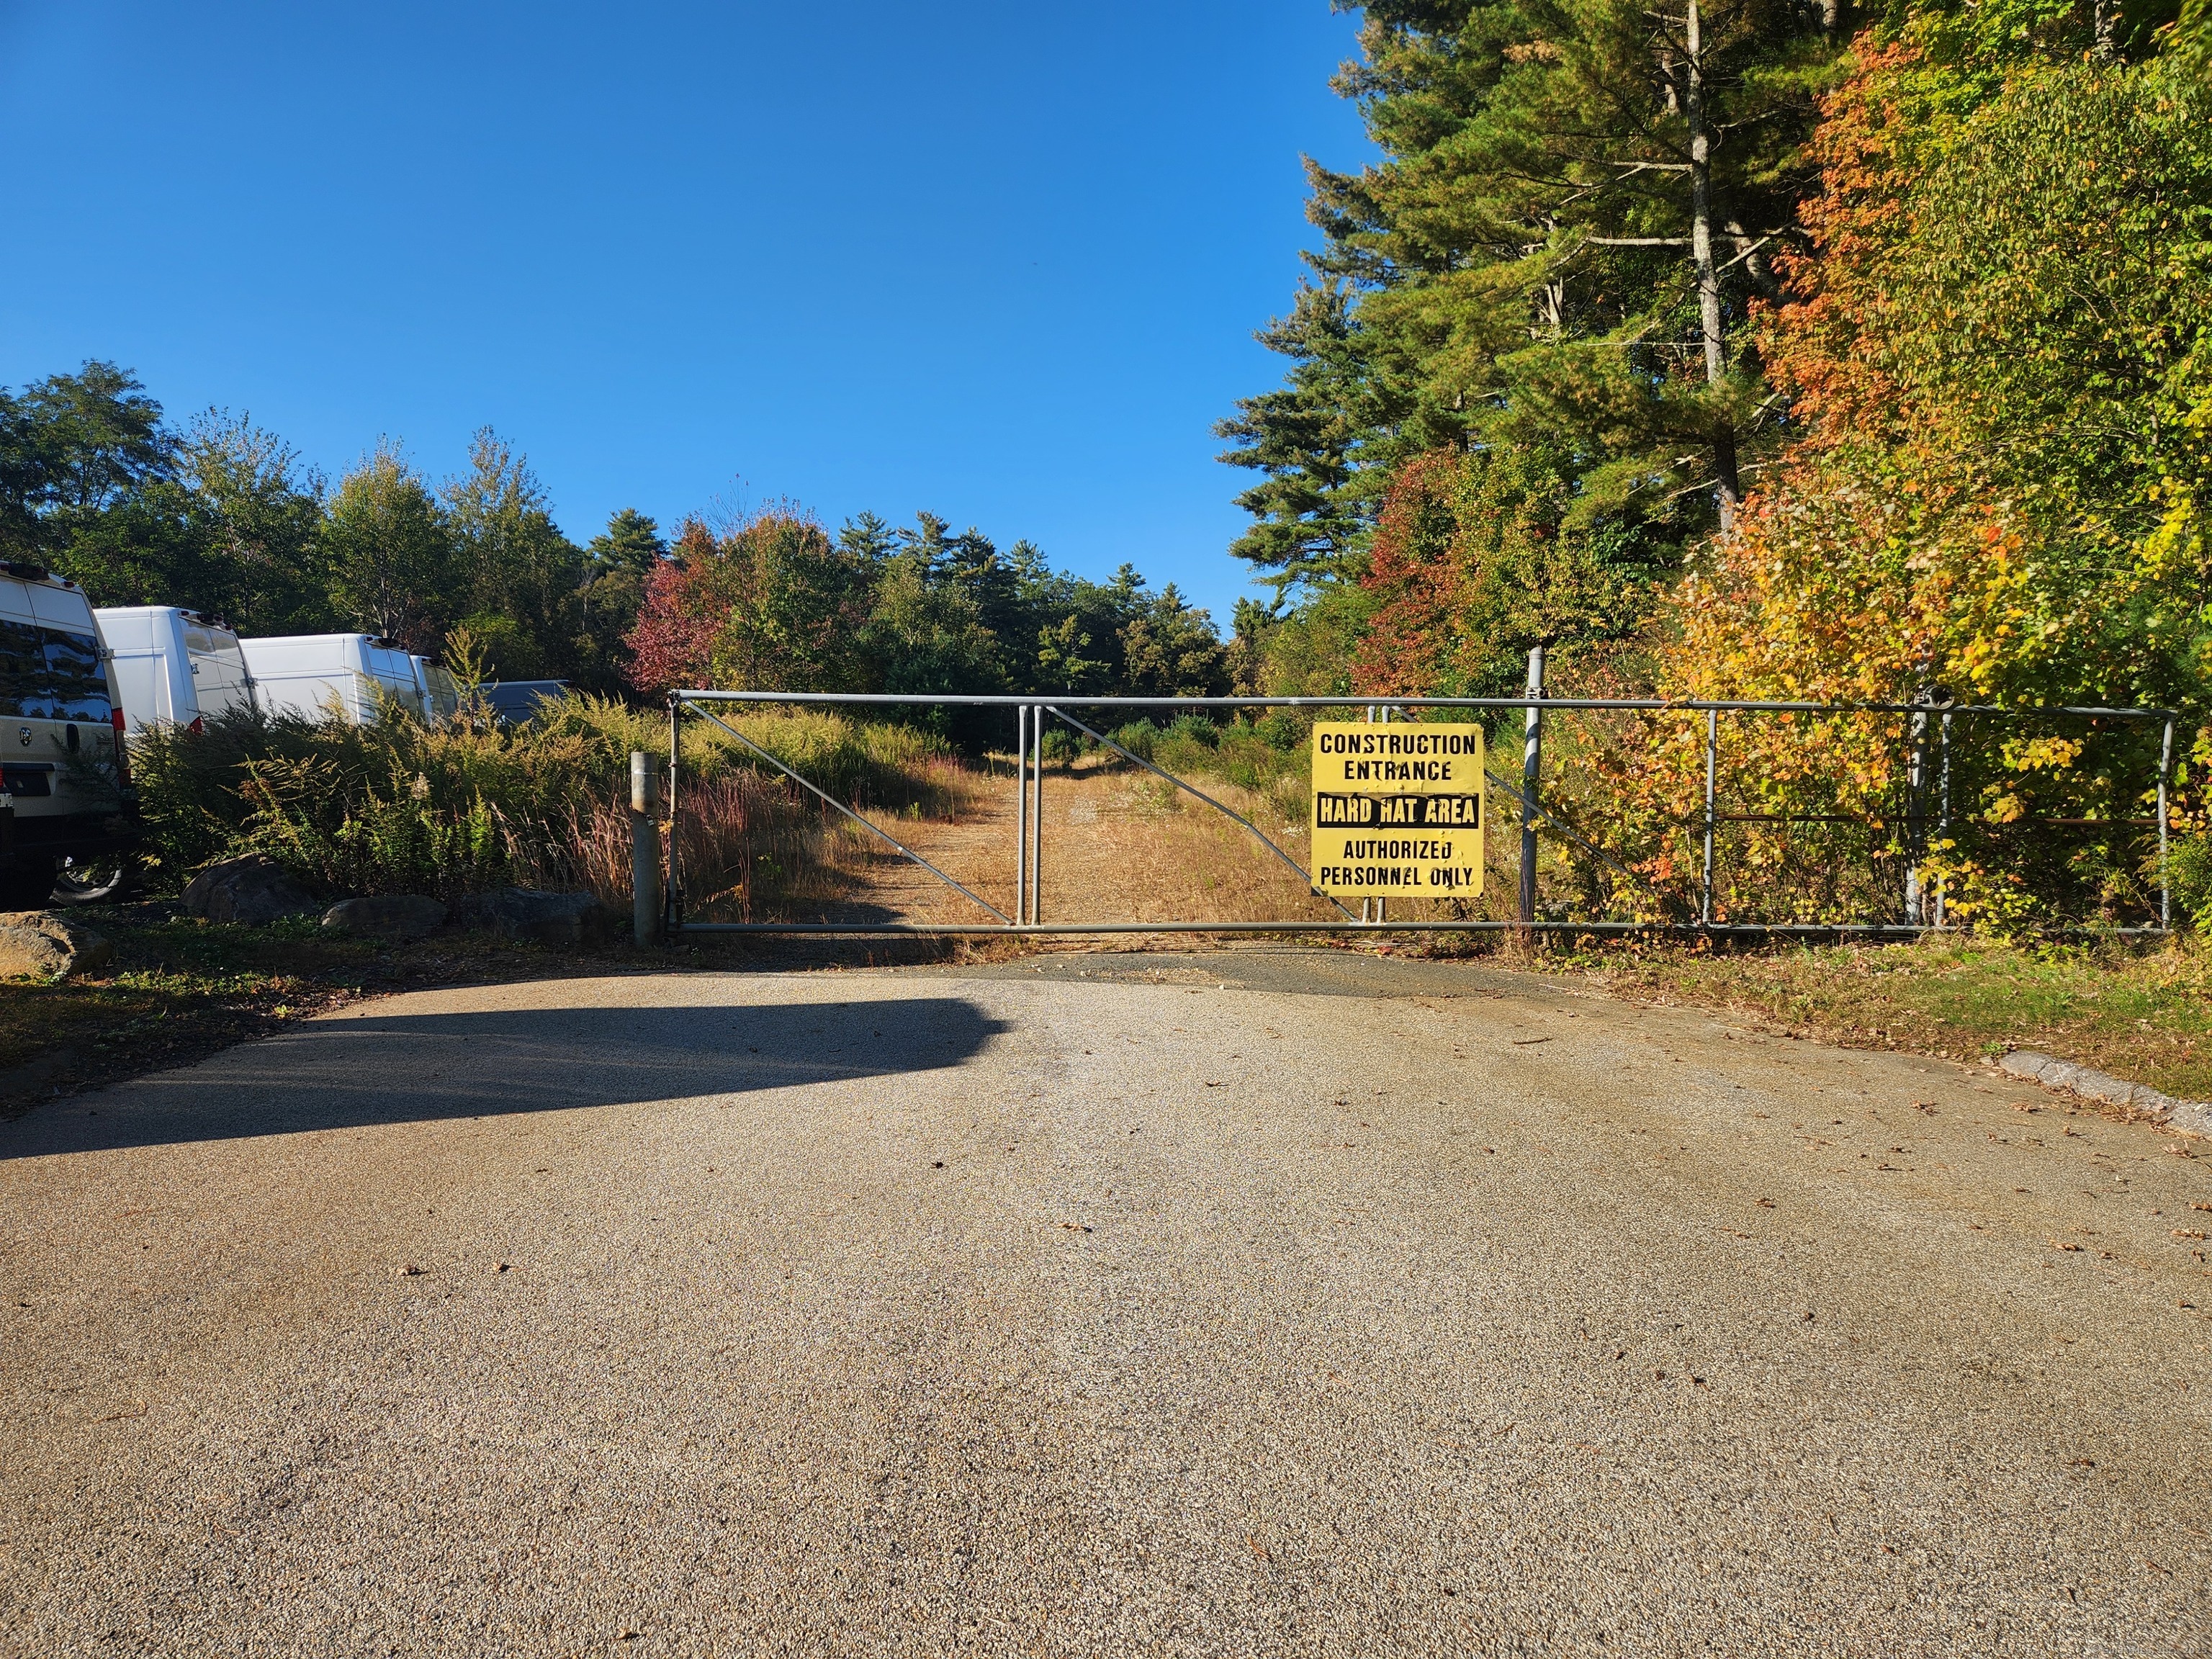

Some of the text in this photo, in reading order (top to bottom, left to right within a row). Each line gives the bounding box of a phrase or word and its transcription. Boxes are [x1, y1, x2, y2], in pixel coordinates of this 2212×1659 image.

[1320, 733, 1475, 755] CONSTRUCTION
[1344, 760, 1452, 781] ENTRANCE
[1320, 798, 1475, 824] HARD HAT AREA
[1343, 840, 1452, 859] AUTHORIZED
[1321, 866, 1473, 886] PERSONNEL ONLY
